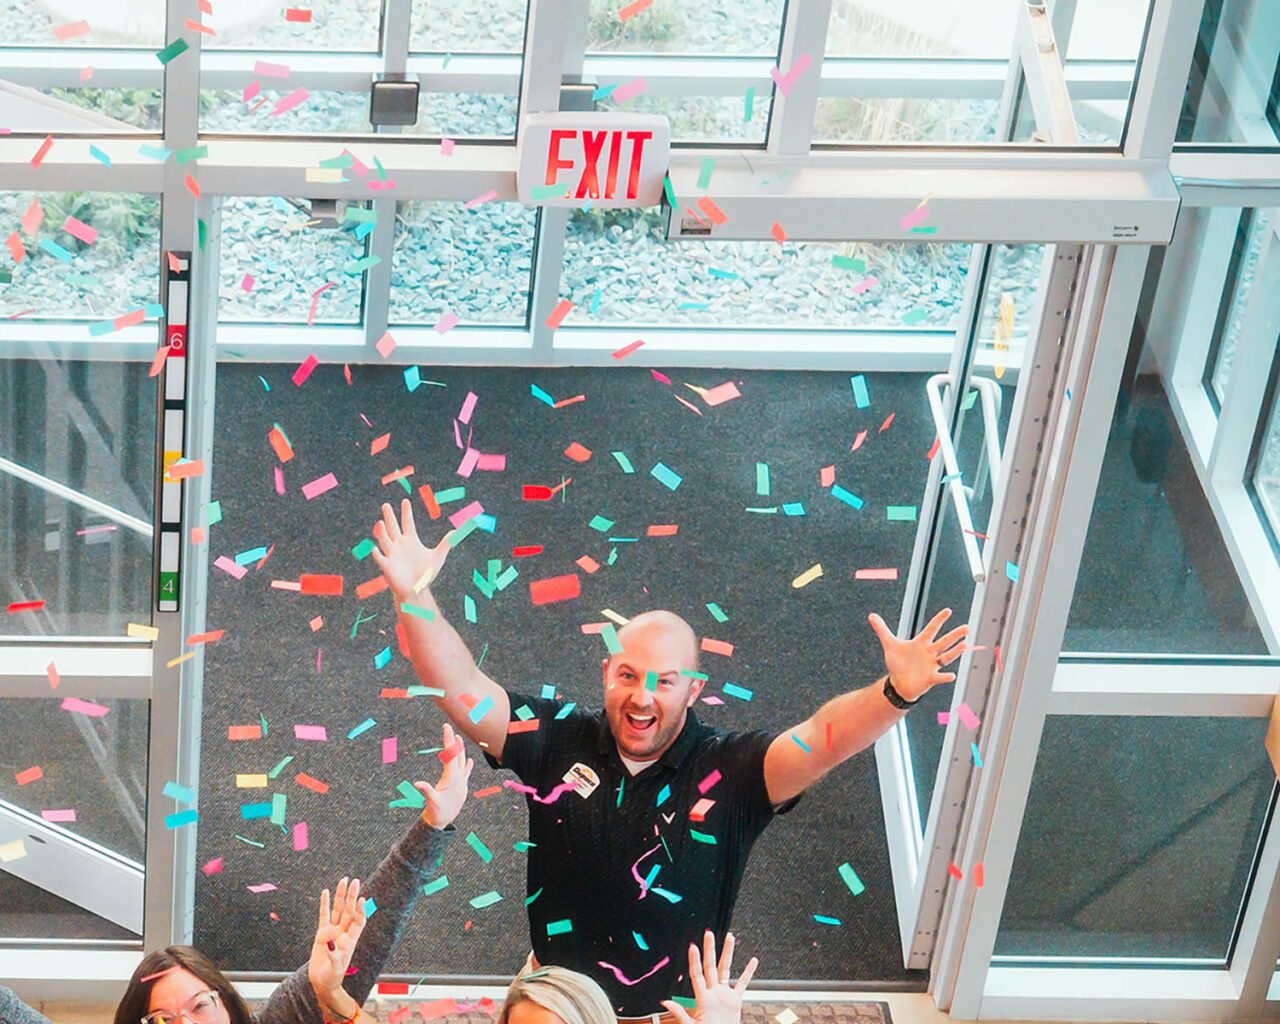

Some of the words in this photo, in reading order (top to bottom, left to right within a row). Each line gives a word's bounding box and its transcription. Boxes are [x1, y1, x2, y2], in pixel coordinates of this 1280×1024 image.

[544, 128, 654, 200] EXIT
[170, 332, 183, 350] 6
[162, 578, 174, 594] 4
